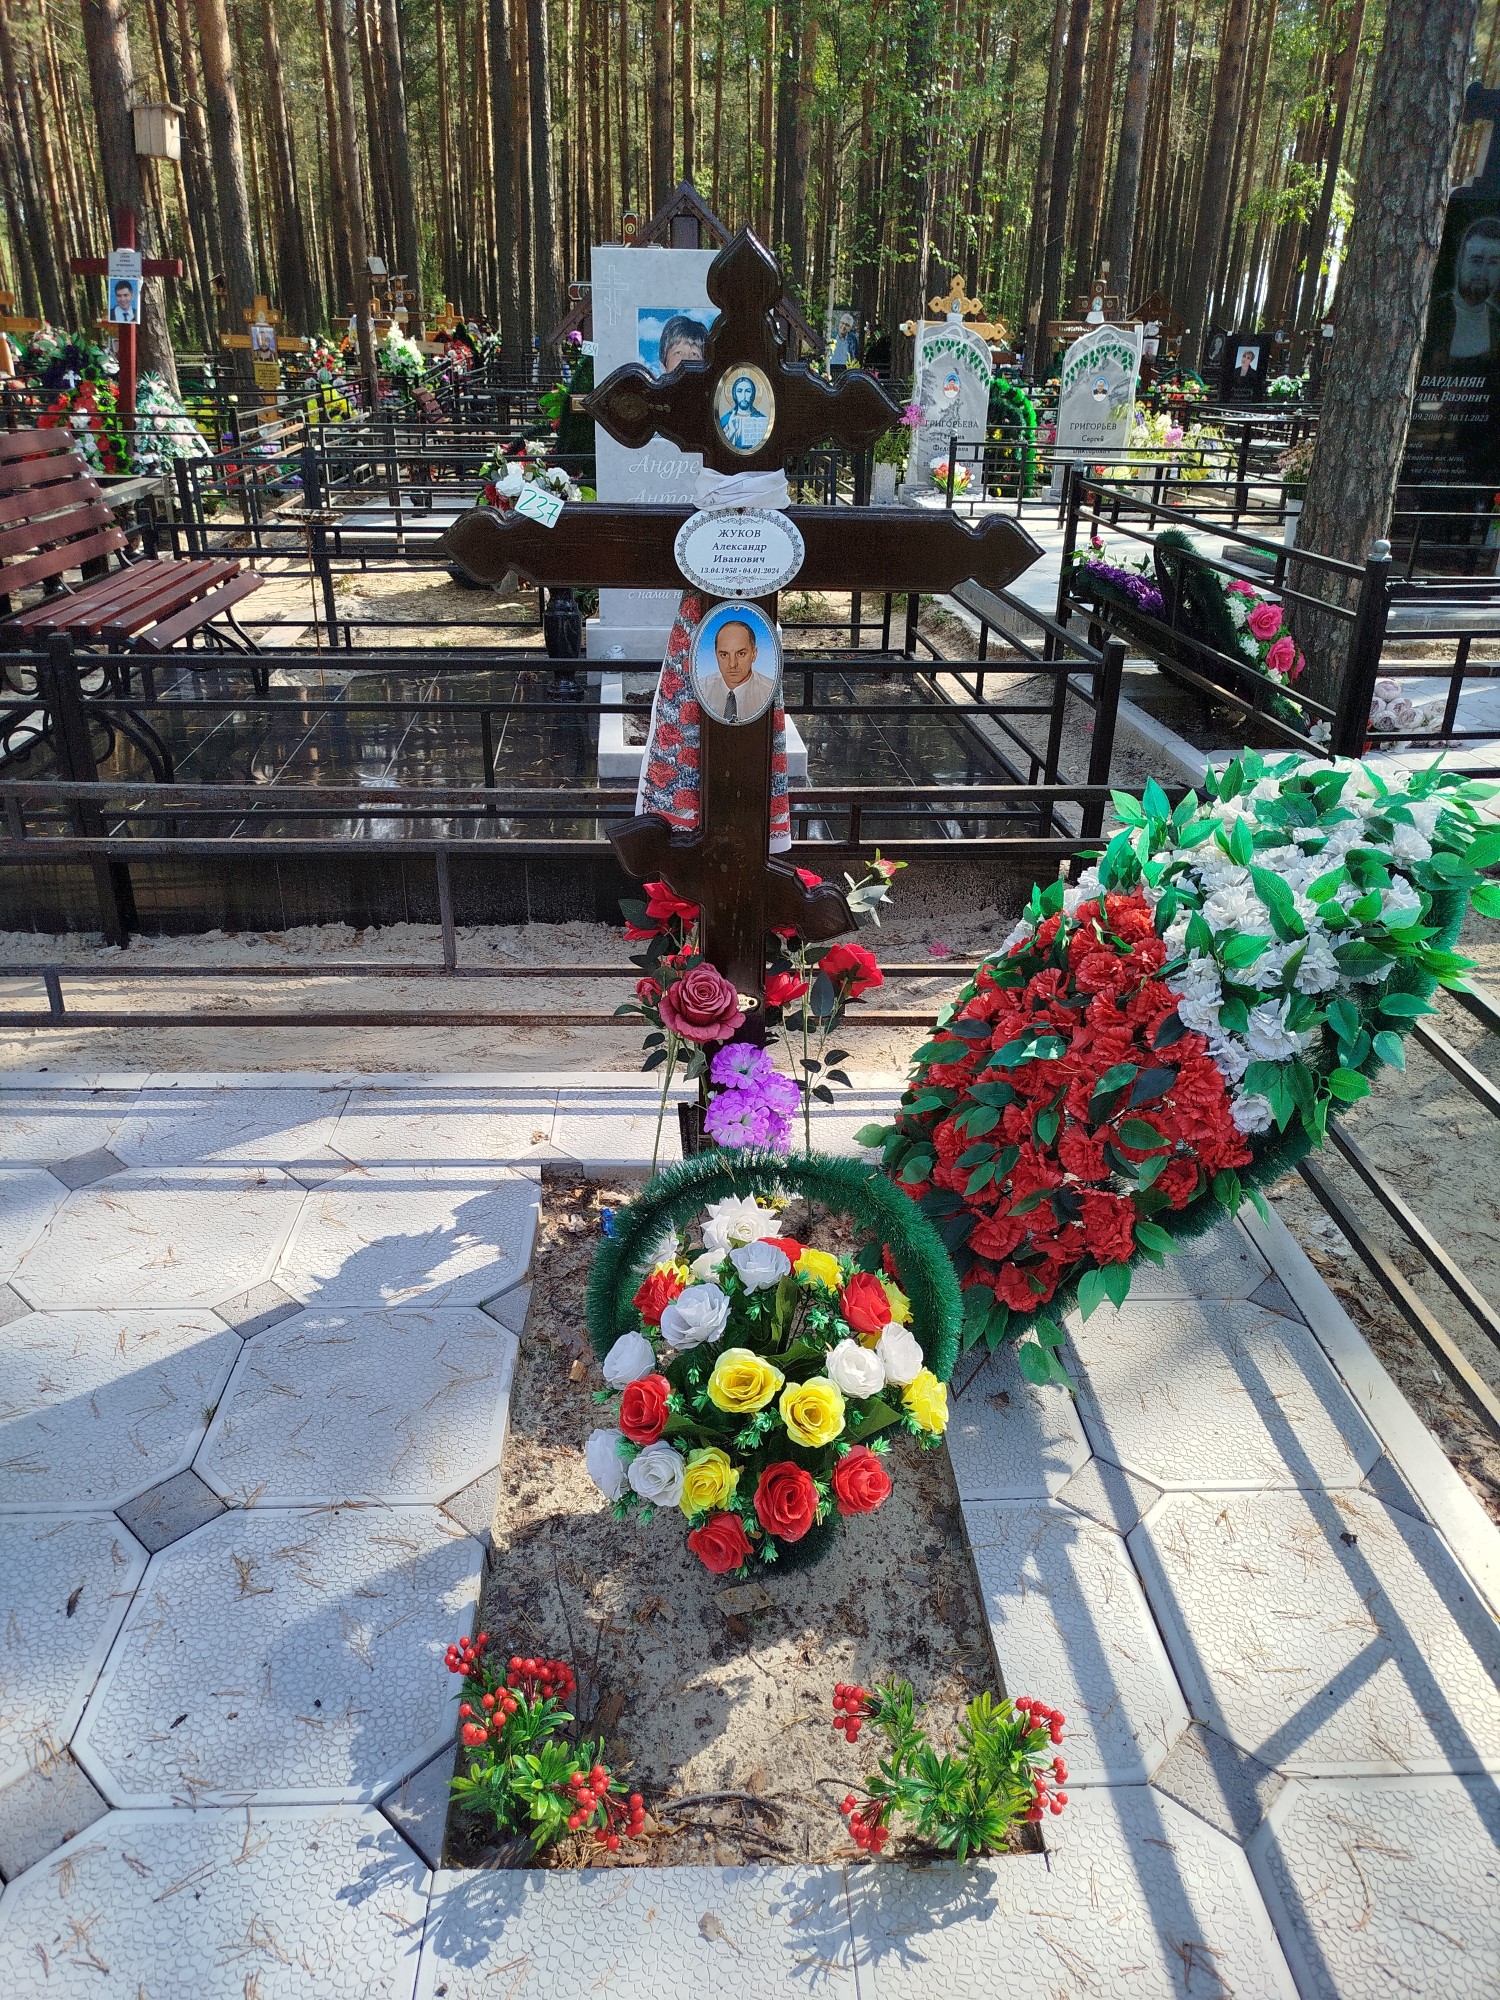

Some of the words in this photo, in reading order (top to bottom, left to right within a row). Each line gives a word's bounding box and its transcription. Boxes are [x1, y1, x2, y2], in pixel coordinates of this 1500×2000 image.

[1420, 376, 1486, 389] ВАРДАНЯН
[925, 420, 979, 429] ГРИГОРЬЕВА
[1069, 422, 1117, 431] ГРИГОРЬЕВ
[518, 489, 560, 524] 237
[717, 529, 762, 539] ЖУКОВ
[711, 542, 768, 553] Александр
[713, 554, 766, 564] Иванович
[742, 567, 780, 575] 04.01.2024
